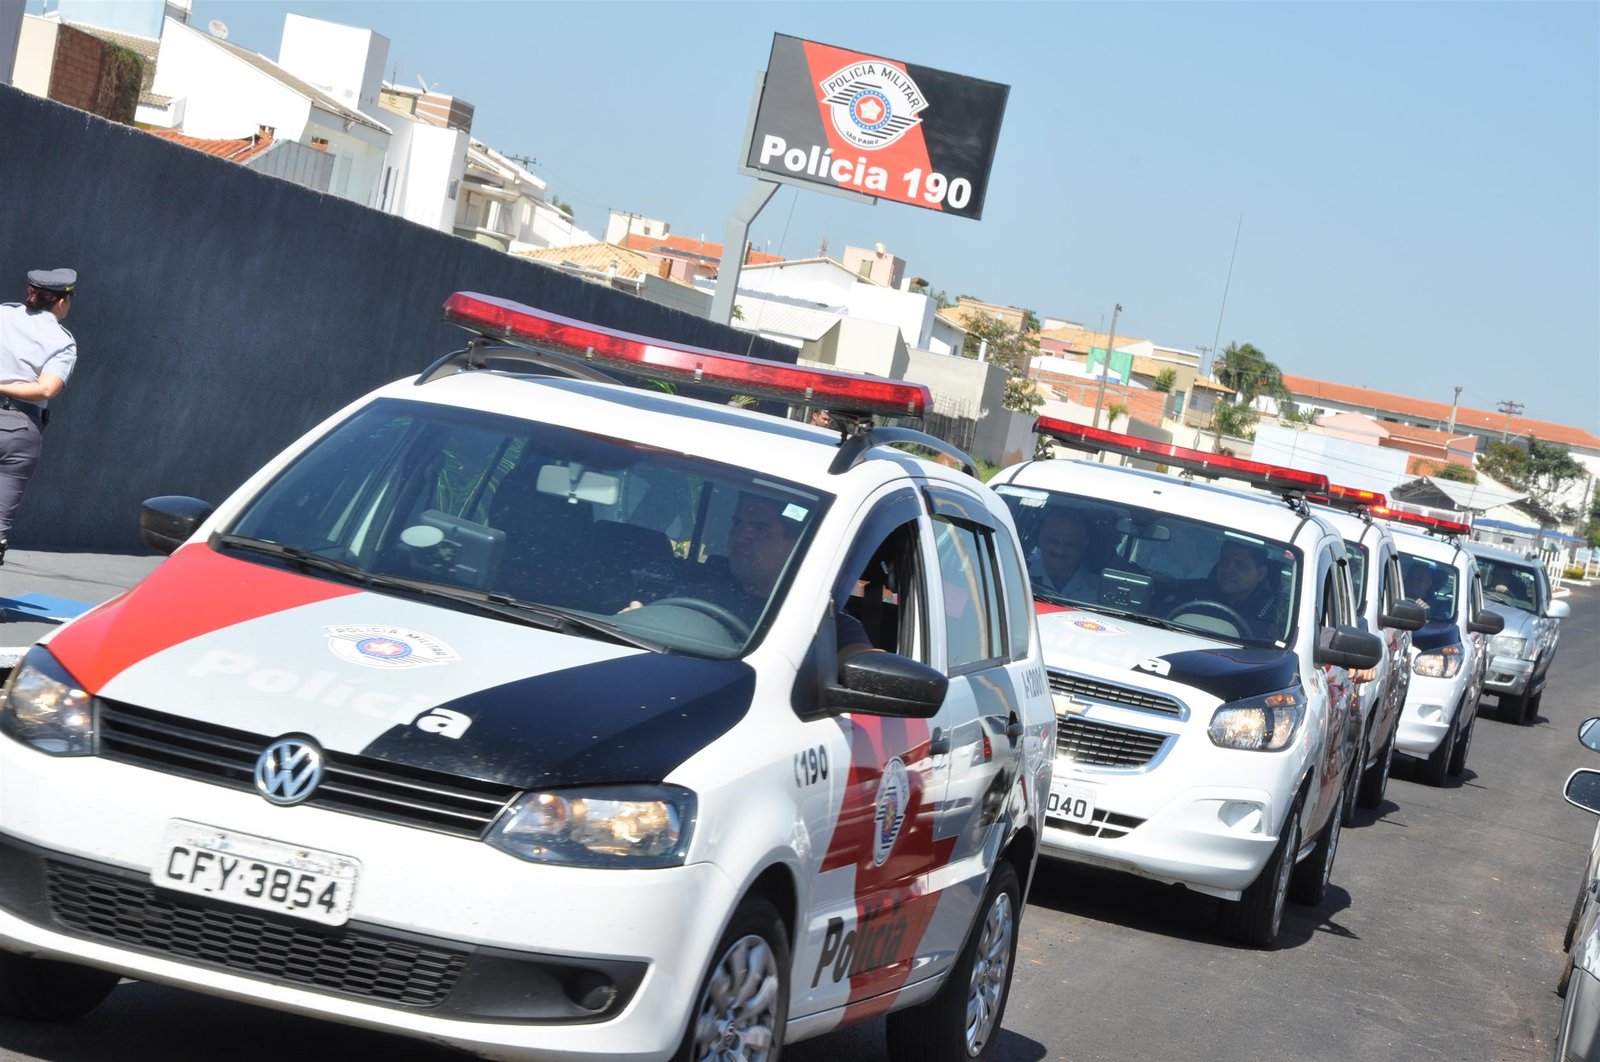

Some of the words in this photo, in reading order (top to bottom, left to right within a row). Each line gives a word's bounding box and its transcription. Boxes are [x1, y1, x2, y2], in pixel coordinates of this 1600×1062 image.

[828, 64, 876, 92] POLICIA
[880, 67, 920, 109] MILITAR
[759, 135, 888, 192] Polícia
[902, 167, 972, 209] 190
